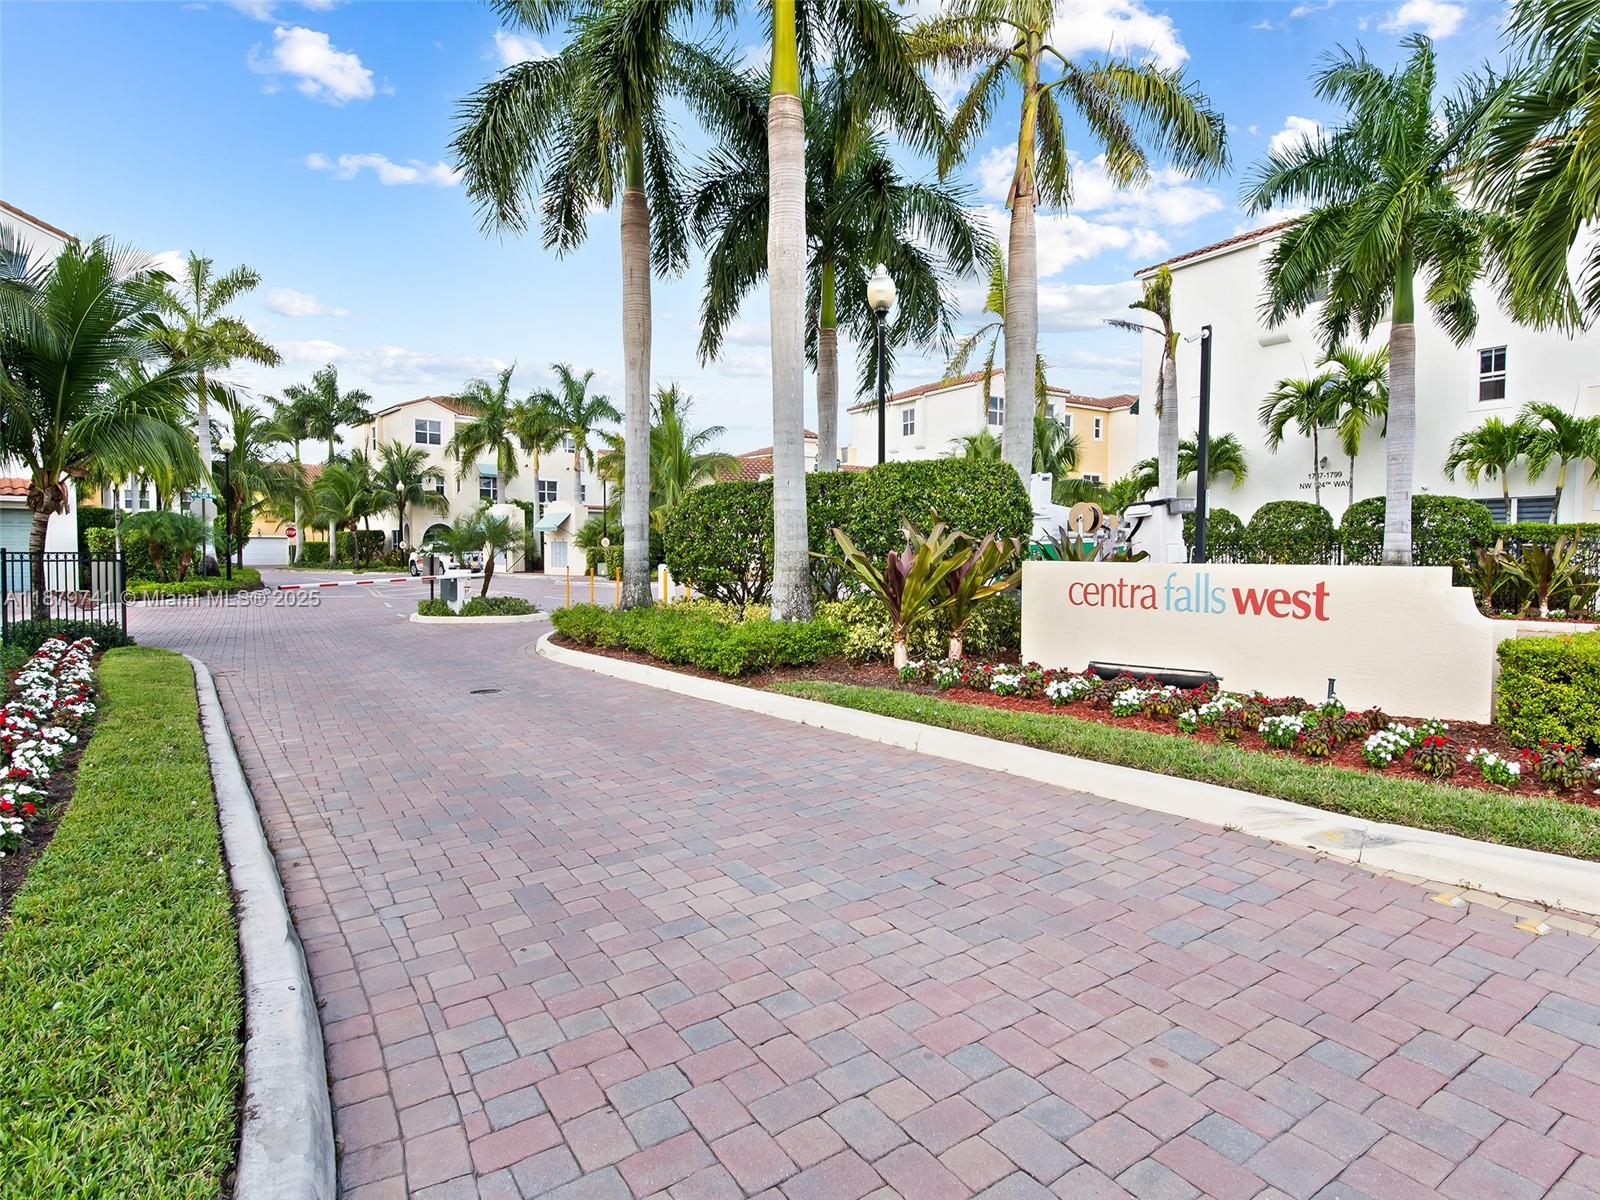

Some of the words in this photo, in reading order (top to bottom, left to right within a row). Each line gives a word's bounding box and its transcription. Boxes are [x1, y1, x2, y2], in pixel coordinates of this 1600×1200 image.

[1333, 480, 1351, 488] WAY
[1068, 577, 1158, 610] centra
[1164, 571, 1226, 615] falls
[1232, 581, 1330, 622] west
